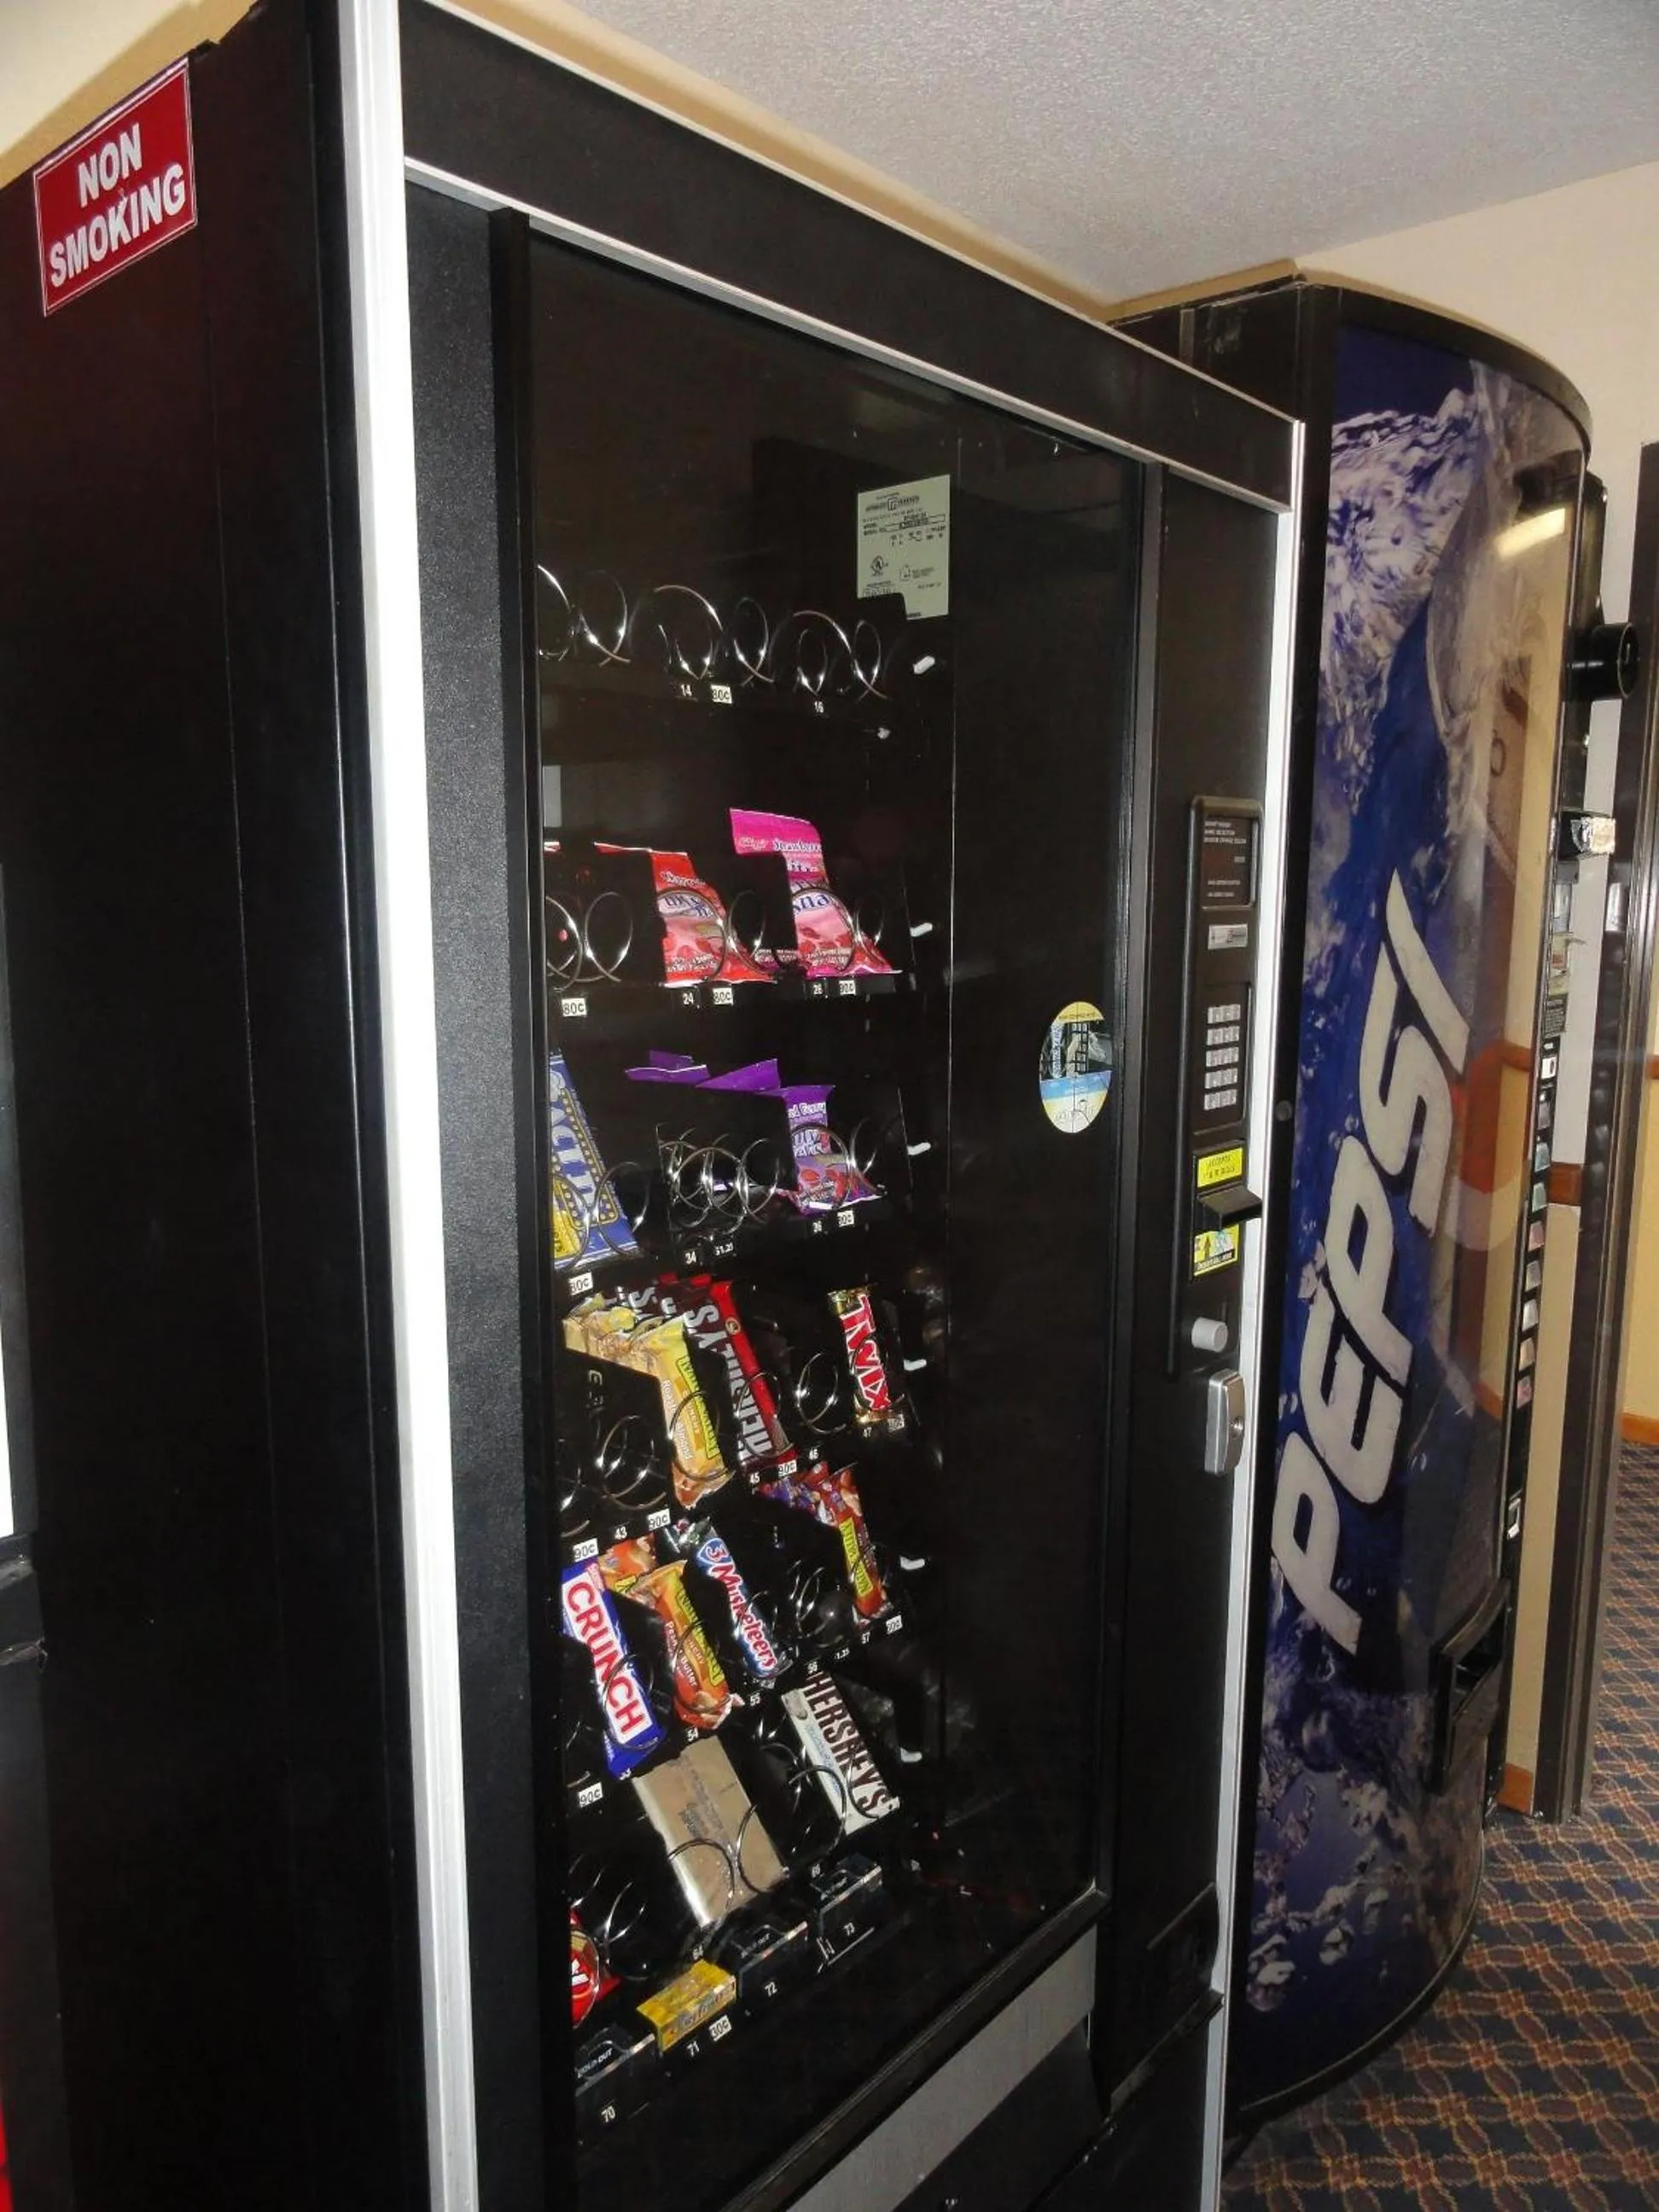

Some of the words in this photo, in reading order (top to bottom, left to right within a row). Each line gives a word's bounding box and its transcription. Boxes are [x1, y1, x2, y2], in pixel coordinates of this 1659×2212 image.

[78, 123, 143, 207] NON
[49, 163, 186, 288] SMOKING
[684, 992, 695, 1004] 24
[685, 1251, 697, 1265] 34
[1272, 865, 1470, 1655] PEPSI
[839, 1292, 892, 1412] TWIX
[615, 1525, 627, 1540] 43
[705, 1542, 730, 1563] 3
[707, 1563, 778, 1670] Musketeers
[566, 1580, 645, 1734] CRUNCH
[749, 1692, 761, 1707] 55
[803, 1670, 894, 1813] HERSHEY'S
[842, 1922, 855, 1936] 73
[765, 1981, 778, 1997] 72
[687, 2040, 700, 2057] 71
[602, 2105, 616, 2123] 70
